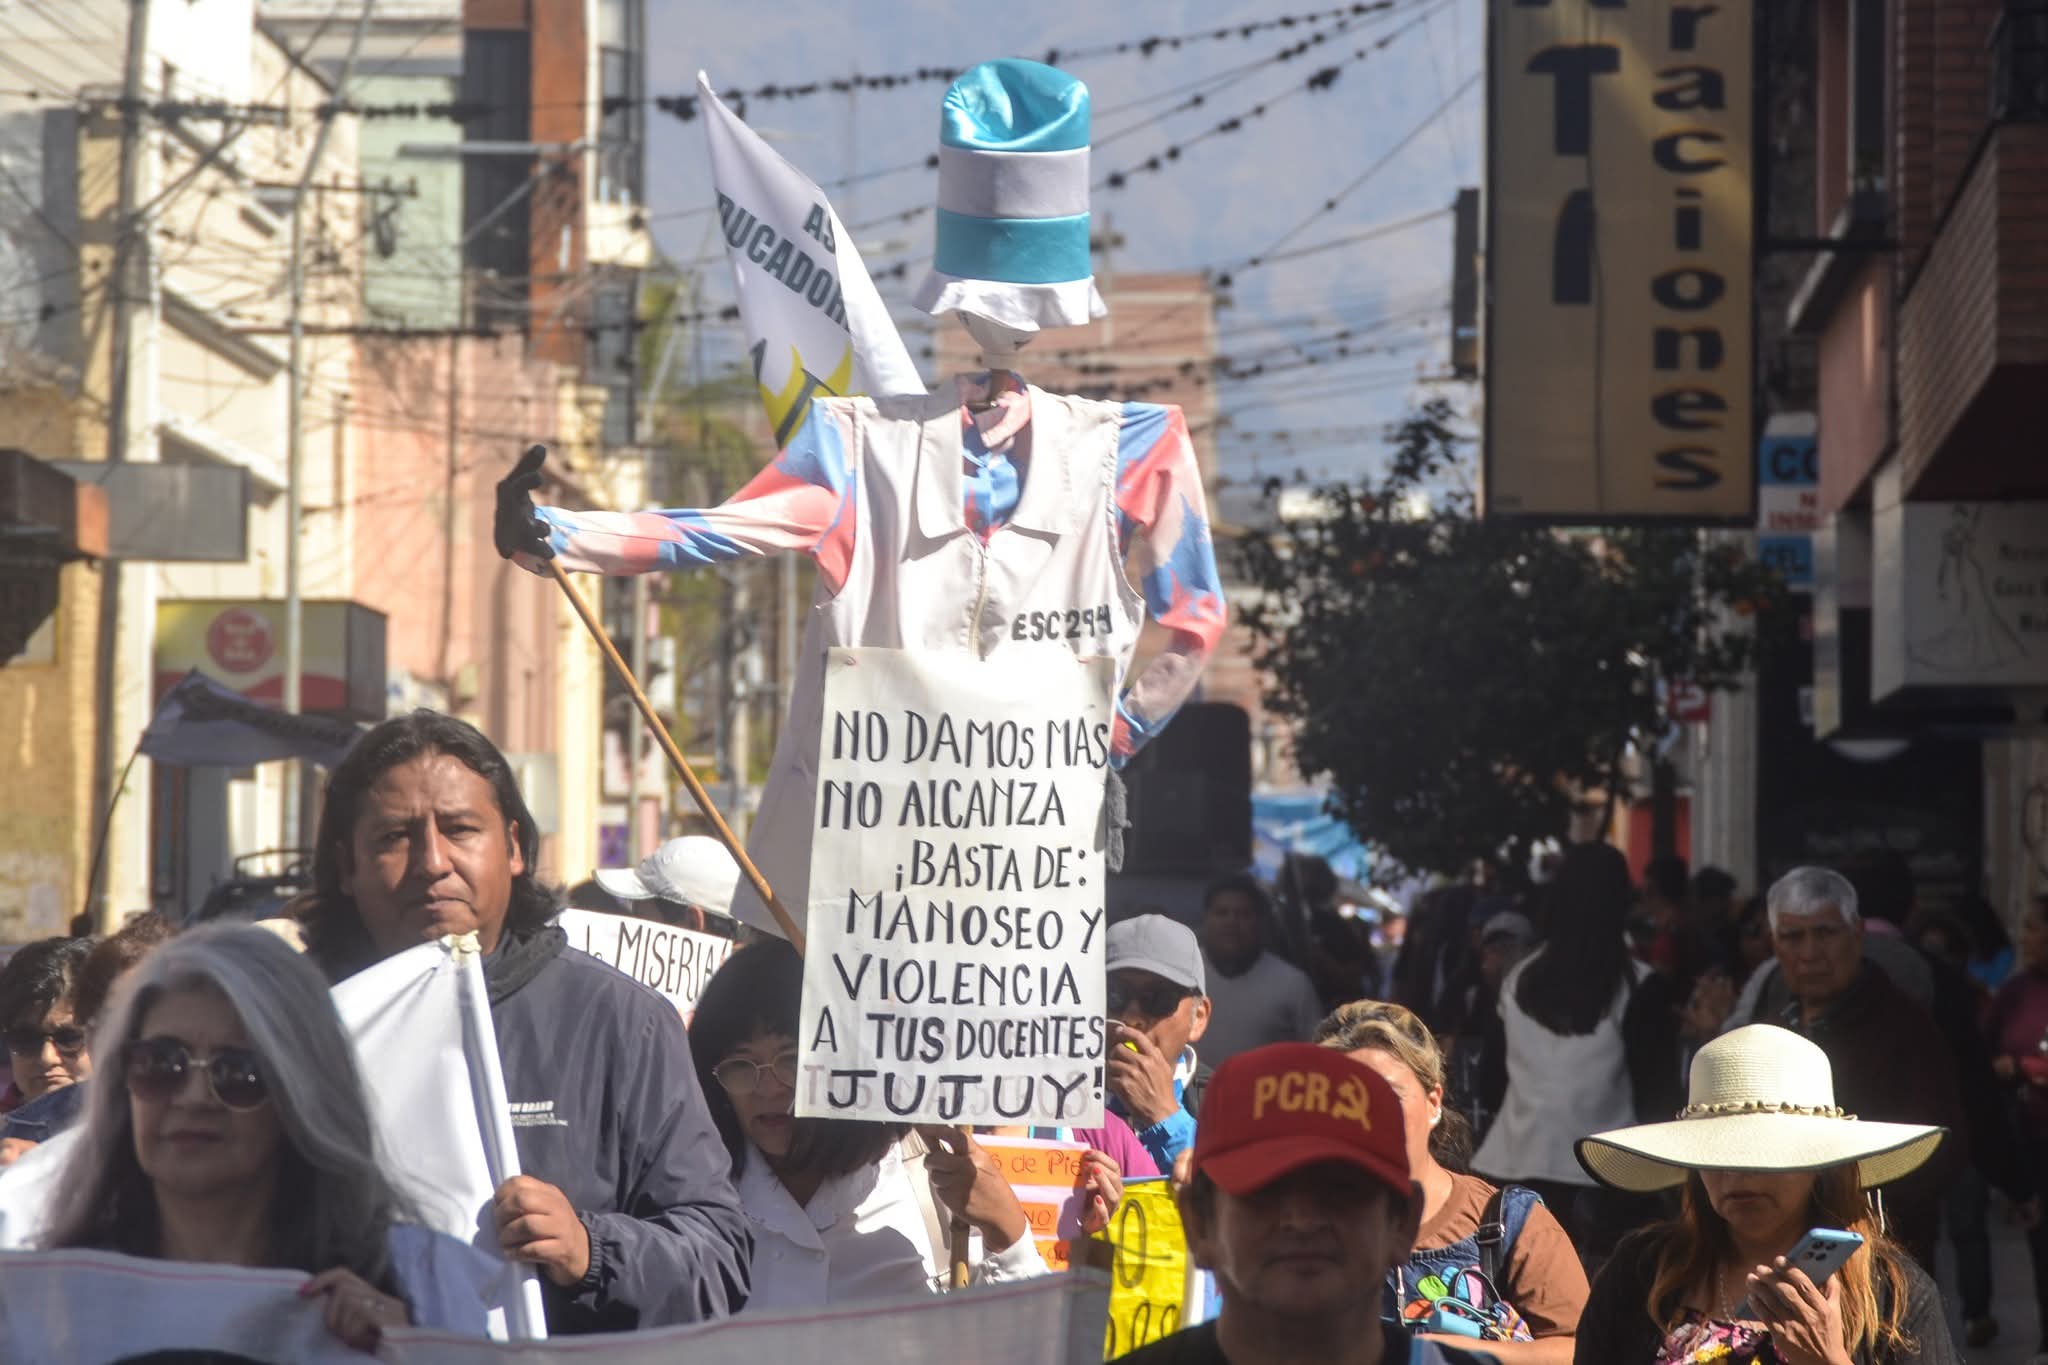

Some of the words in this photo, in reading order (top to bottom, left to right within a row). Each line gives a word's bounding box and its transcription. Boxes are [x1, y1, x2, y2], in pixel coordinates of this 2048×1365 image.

[832, 710, 889, 763] NO
[902, 710, 1034, 769] DAMOS
[820, 779, 882, 830] NO
[897, 777, 1066, 829] ALCANZA
[1033, 845, 1087, 889] DE:
[846, 887, 1064, 951] MANOSEO
[1079, 907, 1104, 954] Y
[832, 952, 1082, 1007] VIOLENCIA
[810, 1004, 838, 1053] A
[866, 1012, 946, 1064] TUS
[956, 1015, 1105, 1062] DOCENTES
[827, 1066, 1104, 1121] JUJUY!
[1253, 1071, 1332, 1120] PCR
